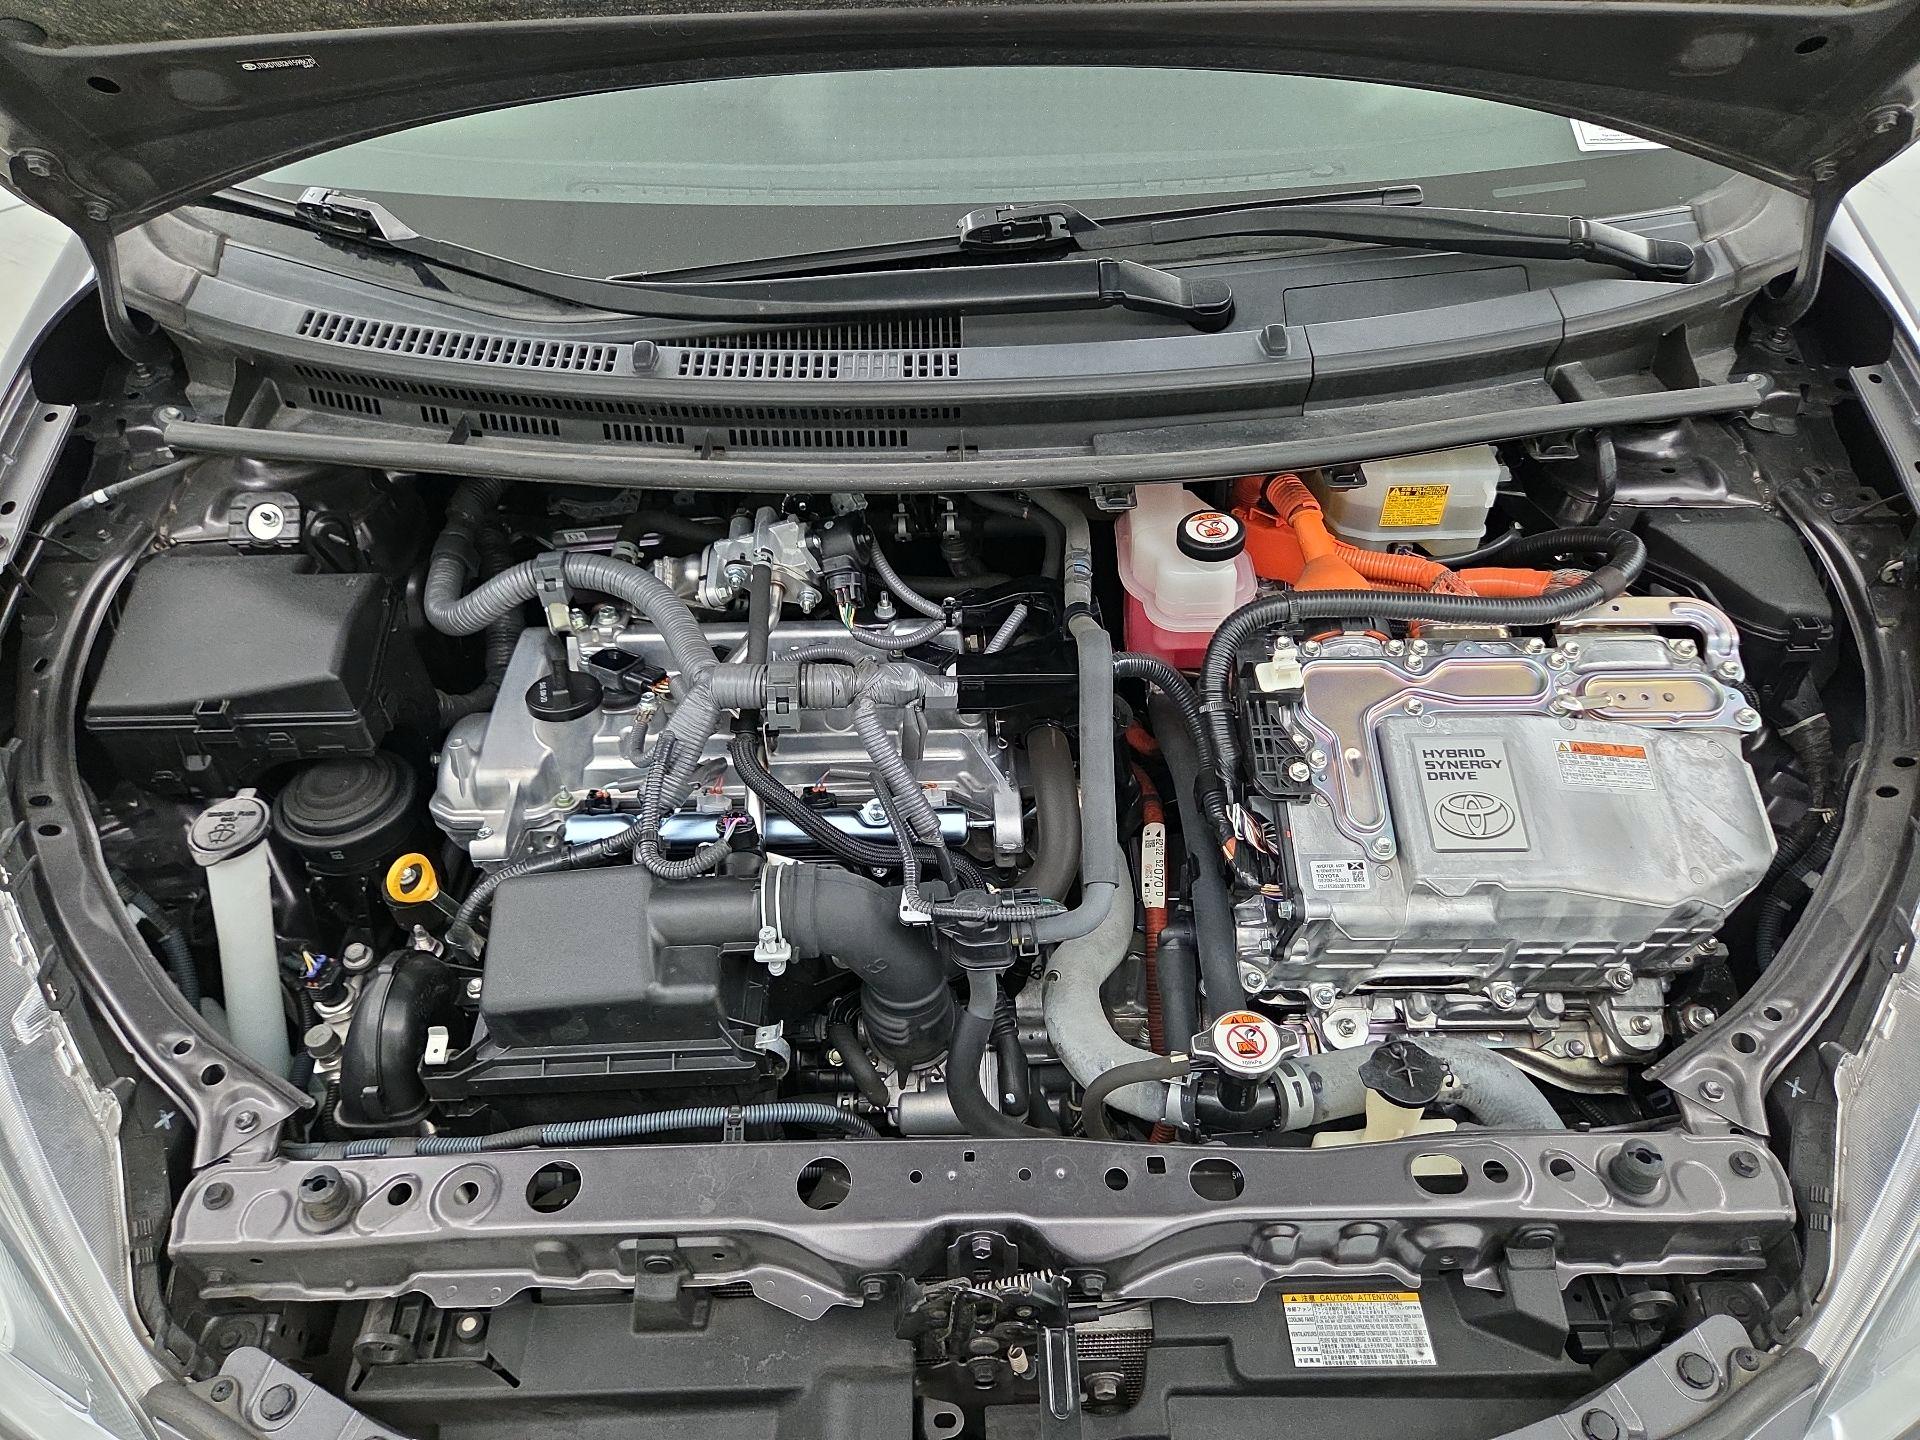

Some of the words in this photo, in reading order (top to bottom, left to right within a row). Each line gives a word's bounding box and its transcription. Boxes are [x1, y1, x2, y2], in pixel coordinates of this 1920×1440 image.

[1422, 749, 1486, 759] HYBRID
[1424, 760, 1502, 770] SYNERGY
[1426, 772, 1478, 781] DRIVE
[1153, 860, 1164, 888] 52070
[1319, 1294, 1354, 1302] CAUTION
[1357, 1293, 1400, 1301] ATTENTION
